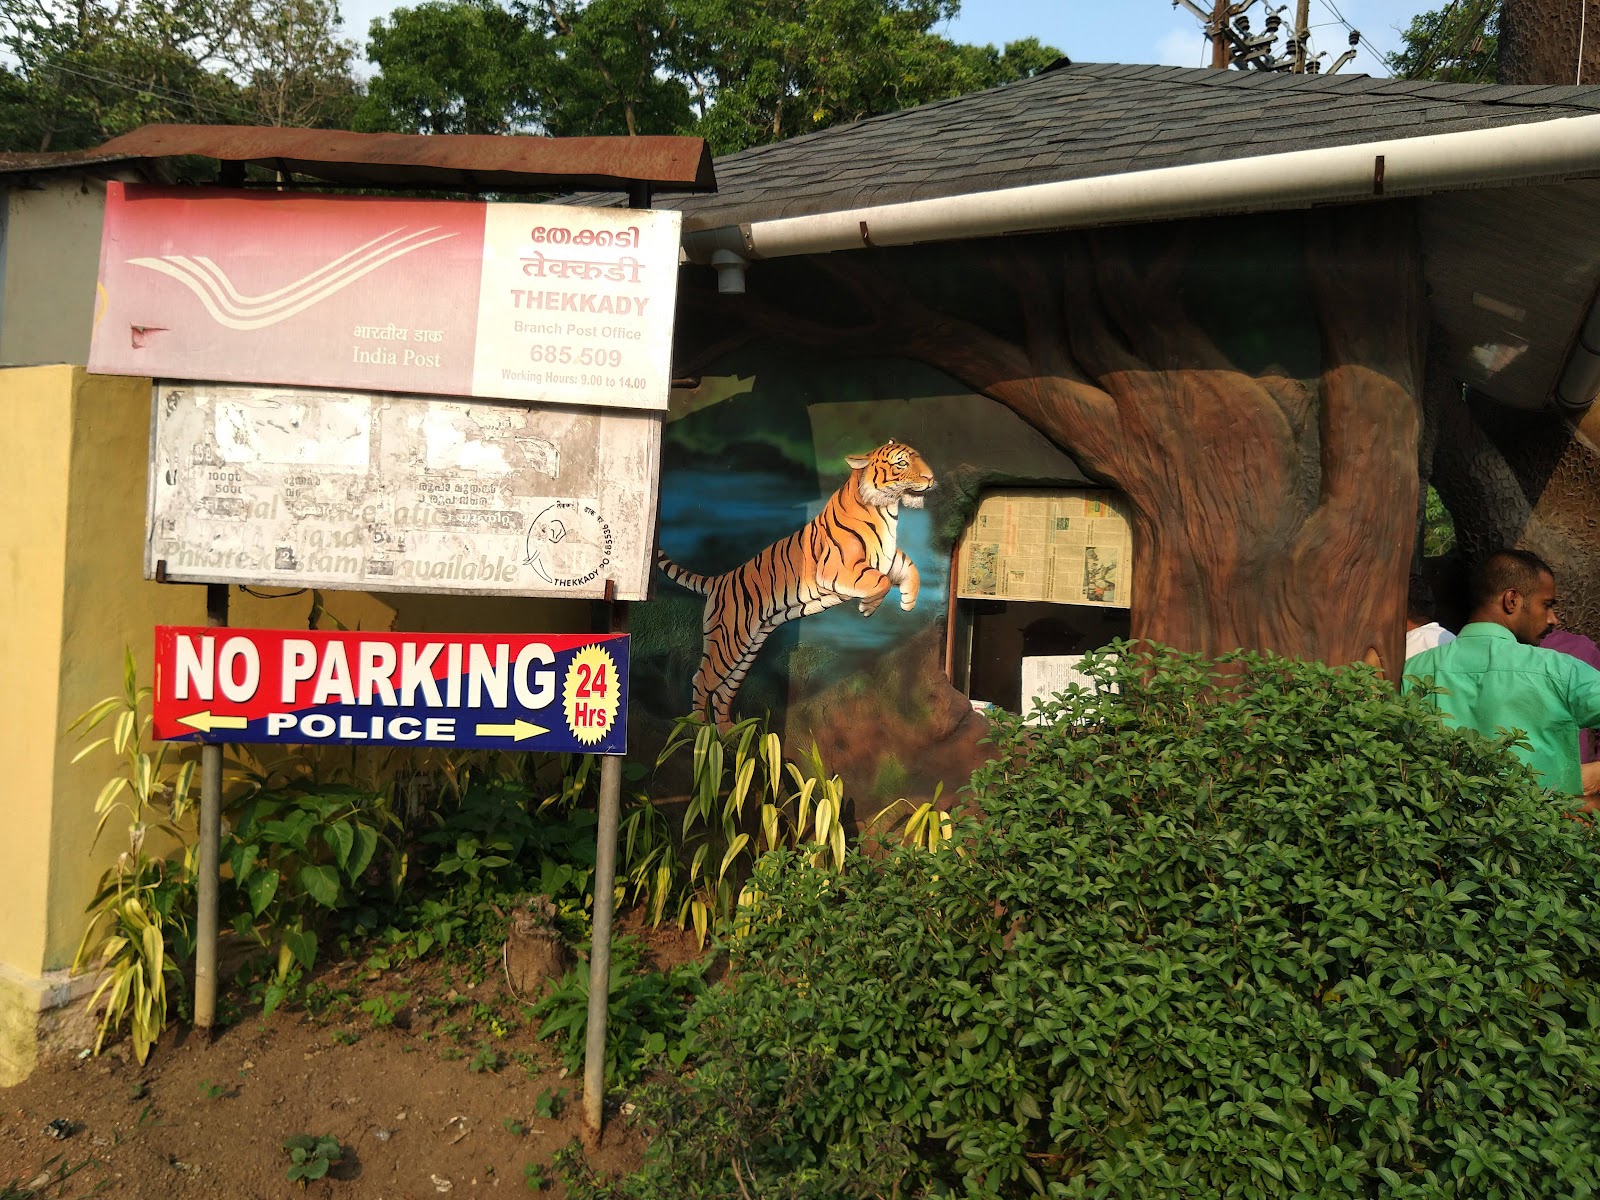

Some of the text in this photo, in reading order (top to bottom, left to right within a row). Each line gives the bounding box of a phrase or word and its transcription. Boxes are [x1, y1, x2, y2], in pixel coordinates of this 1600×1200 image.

[531, 226, 640, 249] തേക്കടി
[520, 250, 646, 283] तेक्कडी
[510, 289, 650, 317] THEKKADY
[353, 323, 445, 343] भारतीय डाक
[514, 320, 642, 340] Branch Post Office
[353, 345, 442, 368] India Post
[530, 344, 622, 367] 685 509
[501, 368, 647, 390] Working Hours: 9.00 to 14.00
[554, 523, 613, 587] THEKKADY PO 685536
[175, 634, 556, 710] NO PARKING
[575, 663, 608, 699] 24
[267, 712, 456, 741] POLICE
[574, 702, 607, 728] Hrs
